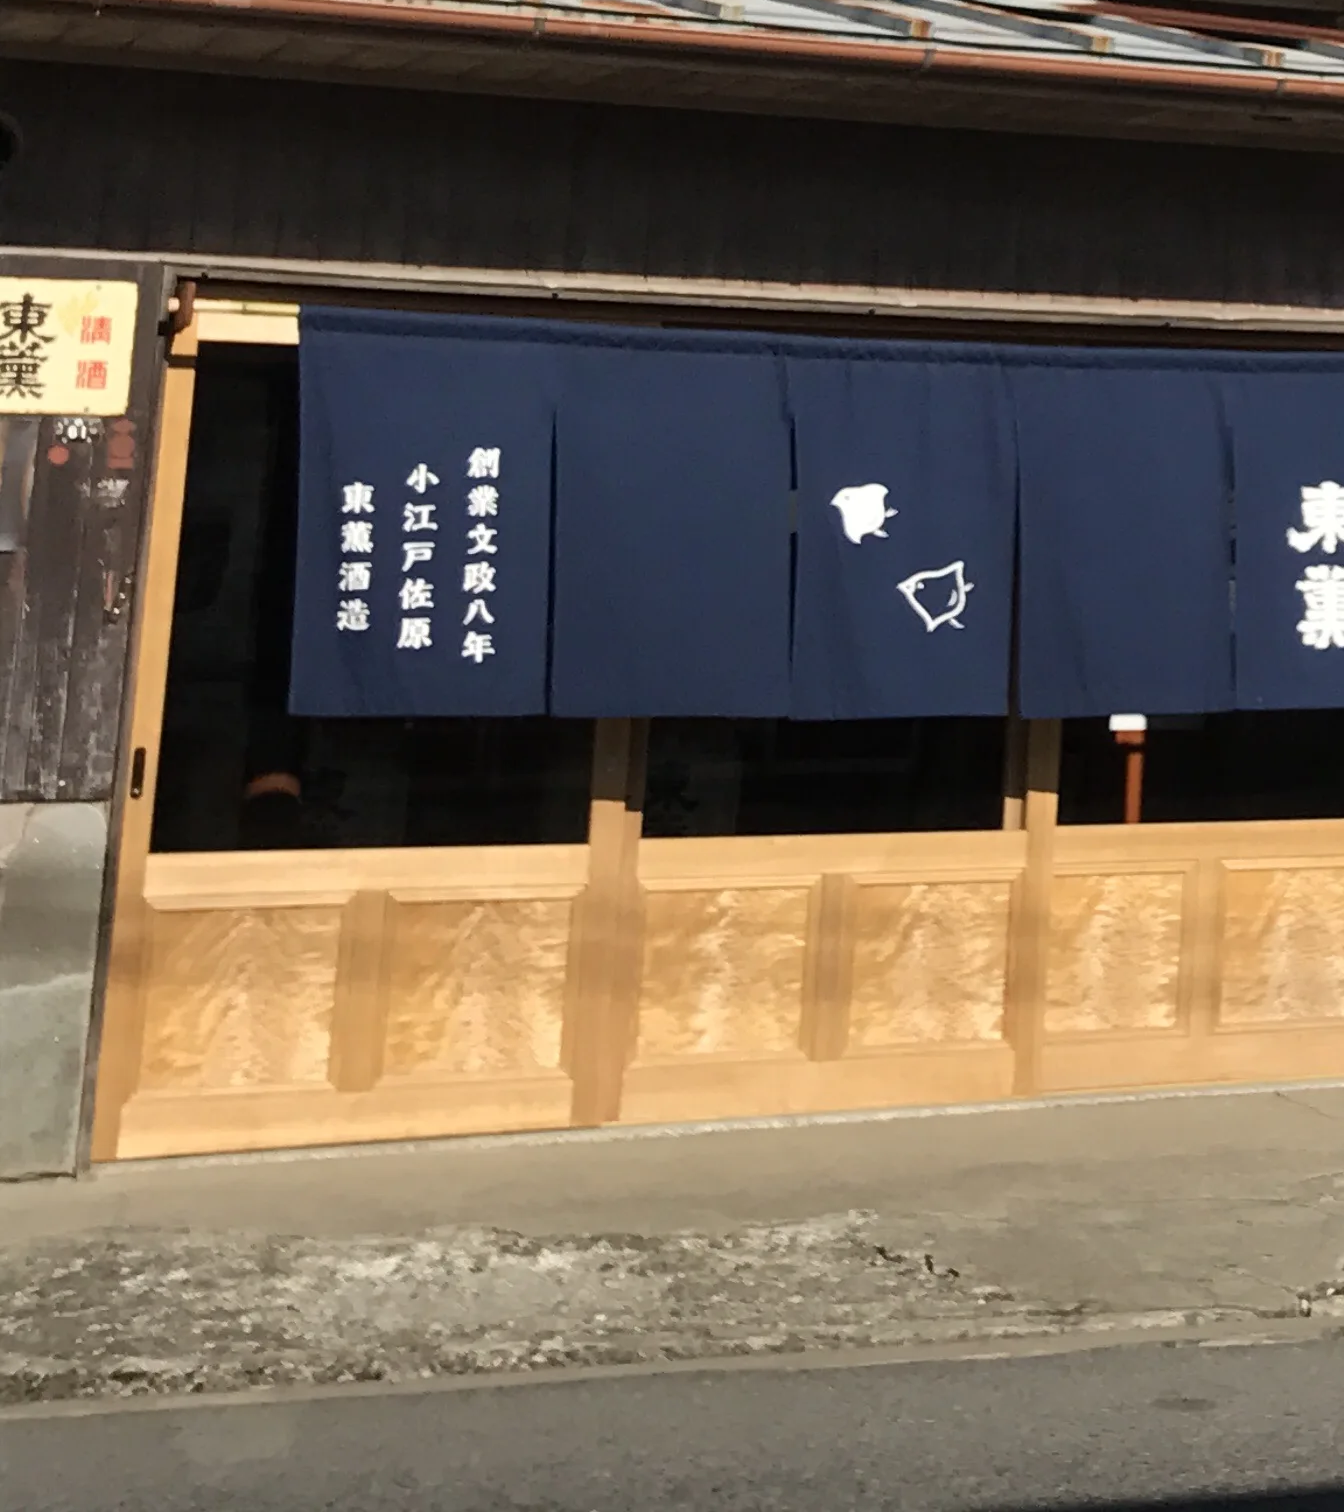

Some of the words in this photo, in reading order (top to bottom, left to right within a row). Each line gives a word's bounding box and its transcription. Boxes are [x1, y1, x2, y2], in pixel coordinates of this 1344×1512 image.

[336, 481, 375, 631] 東薫酒造
[396, 462, 440, 650] 小江戸佐原
[461, 446, 501, 663] 創業文政八年
